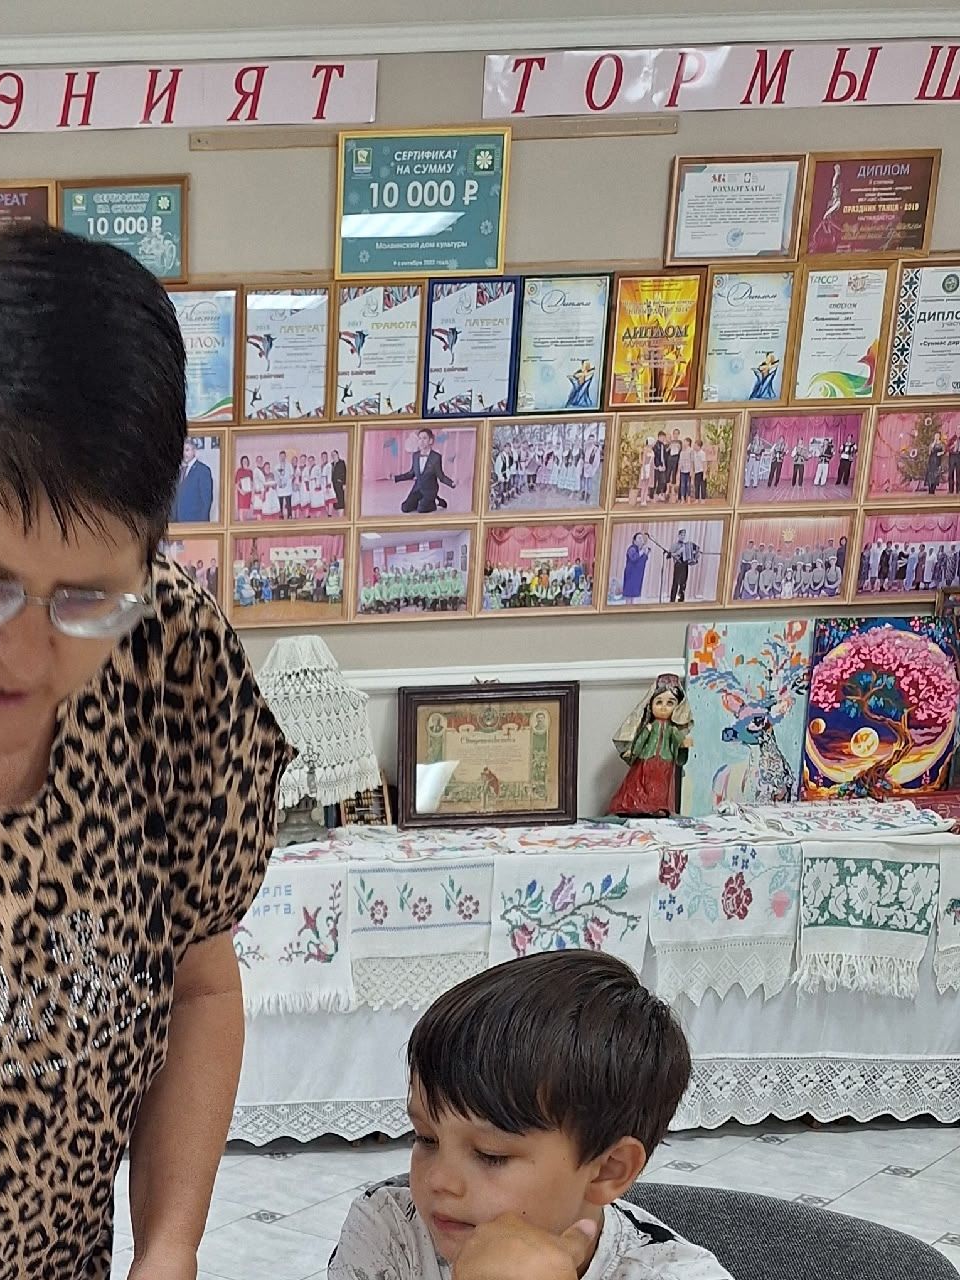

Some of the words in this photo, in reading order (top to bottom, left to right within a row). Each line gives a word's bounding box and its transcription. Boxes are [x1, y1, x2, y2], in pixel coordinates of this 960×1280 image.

[394, 150, 458, 162] СЕРТИФИКАТ
[396, 165, 411, 175] НА
[414, 163, 455, 175] СУММУ
[857, 163, 910, 178] ДИПЛОМ
[369, 182, 399, 208] 10
[407, 180, 455, 207] 000
[843, 204, 876, 214] ПРАЗДНИК
[88, 216, 109, 235] 10
[114, 215, 148, 235] 000
[622, 324, 690, 341] ДИПЛОМ
[184, 336, 225, 349] ПЛОМ
[261, 885, 292, 898] РЛЕ
